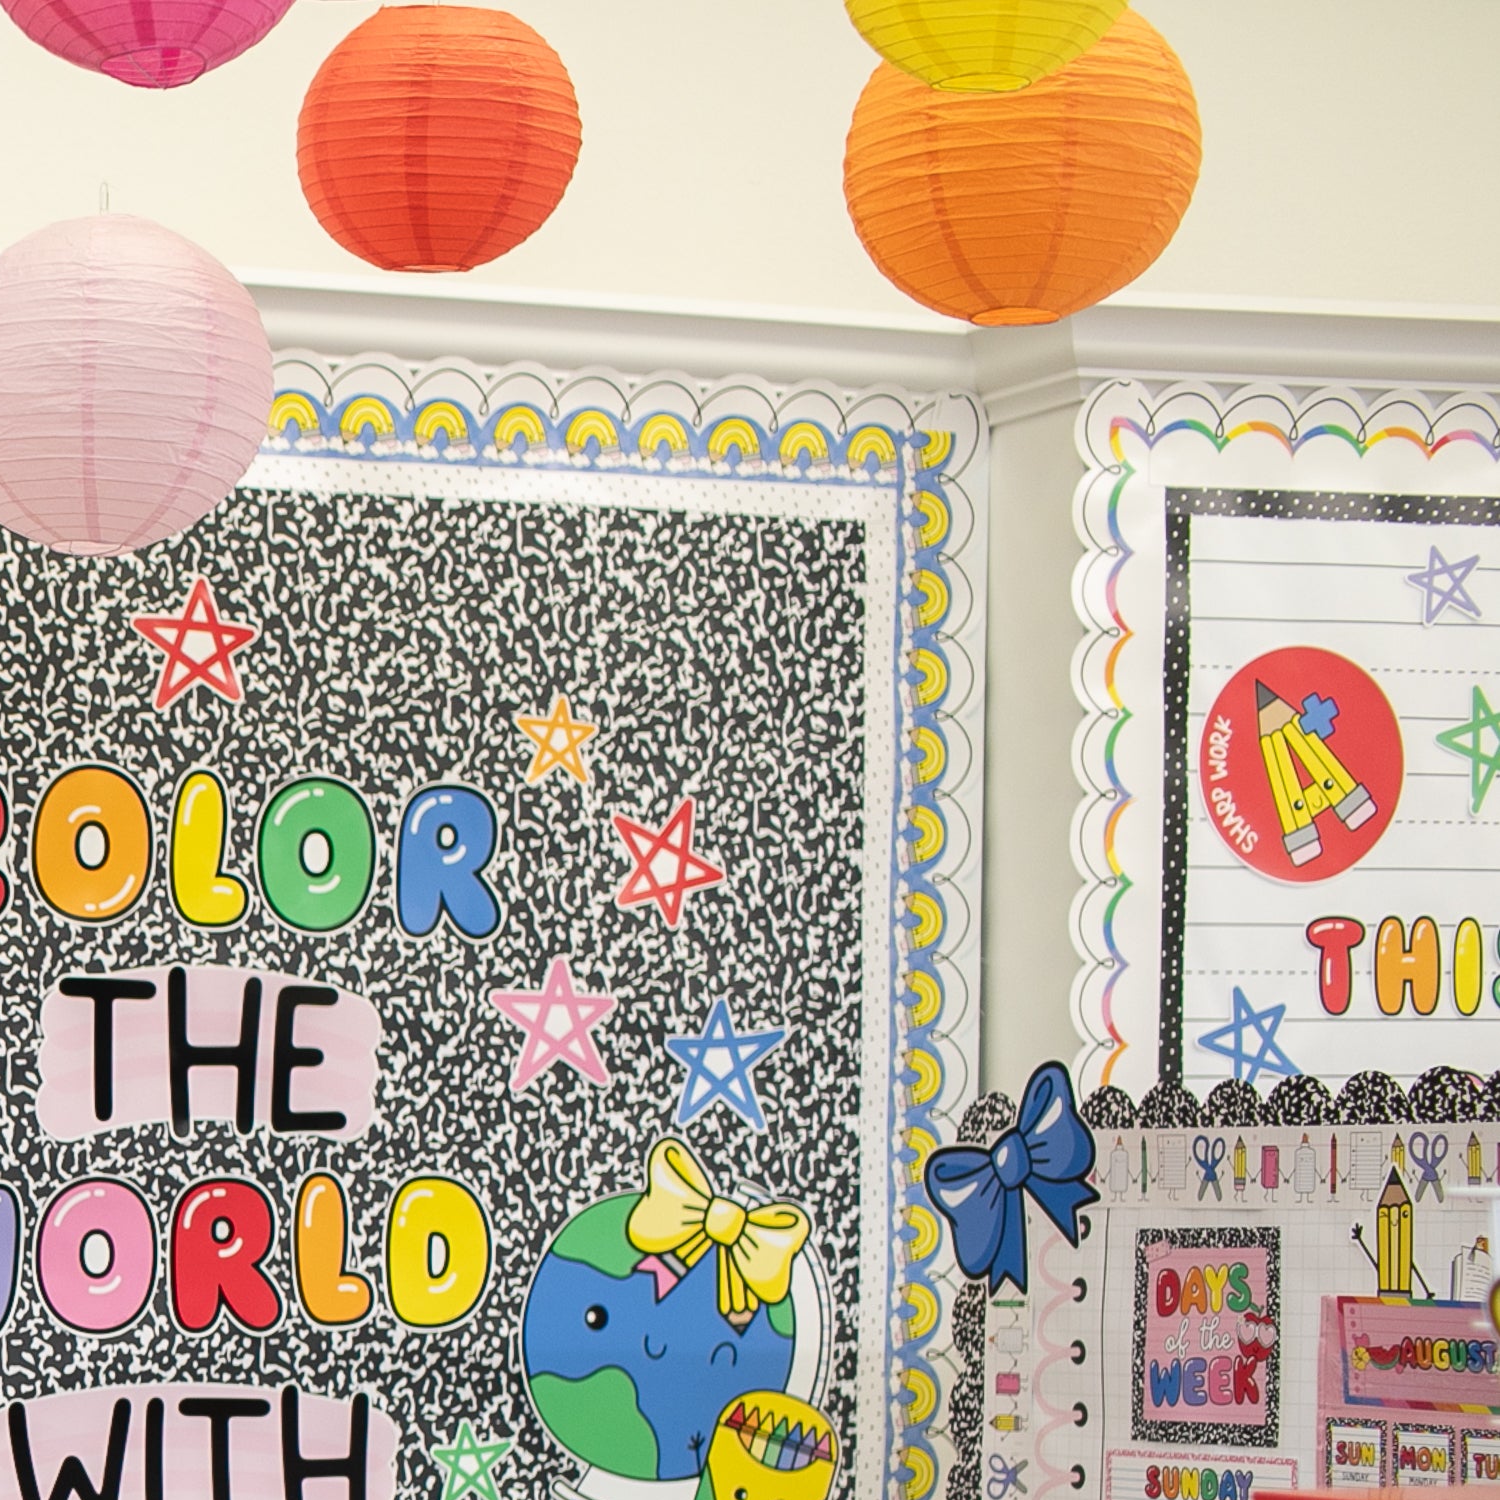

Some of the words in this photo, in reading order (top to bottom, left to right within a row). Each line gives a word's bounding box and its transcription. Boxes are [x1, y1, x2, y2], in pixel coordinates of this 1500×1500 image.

[1210, 714, 1233, 782] WORK
[1211, 787, 1260, 855] SHARP
[1305, 915, 1500, 1017] THI
[57, 966, 348, 1138] THE
[1156, 1262, 1250, 1317] DAYS
[1163, 1317, 1190, 1357] of
[1199, 1317, 1234, 1350] the
[1400, 1336, 1496, 1371] AUGUST
[1150, 1355, 1260, 1407] WEEK
[1336, 1441, 1375, 1466] SUN
[1399, 1445, 1446, 1472] MON
